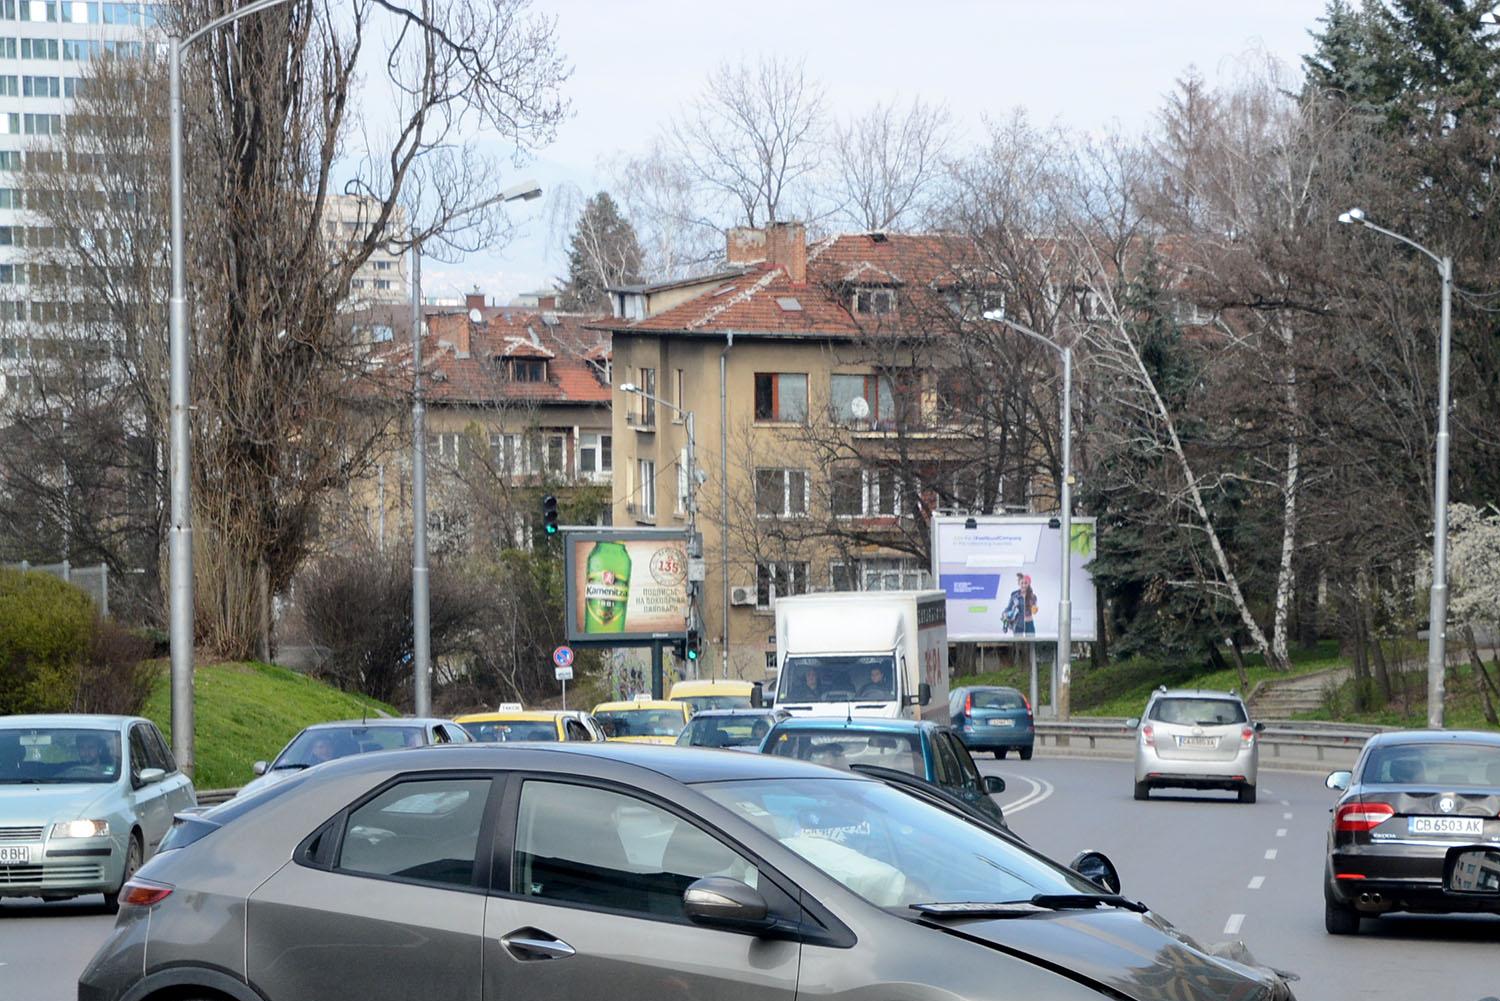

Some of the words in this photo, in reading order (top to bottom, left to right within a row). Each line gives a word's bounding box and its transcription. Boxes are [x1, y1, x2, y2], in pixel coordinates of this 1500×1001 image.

[660, 560, 679, 574] 135
[586, 585, 628, 597] Kamenitza
[1434, 820, 1463, 832] 6503
[1466, 820, 1480, 833] AK
